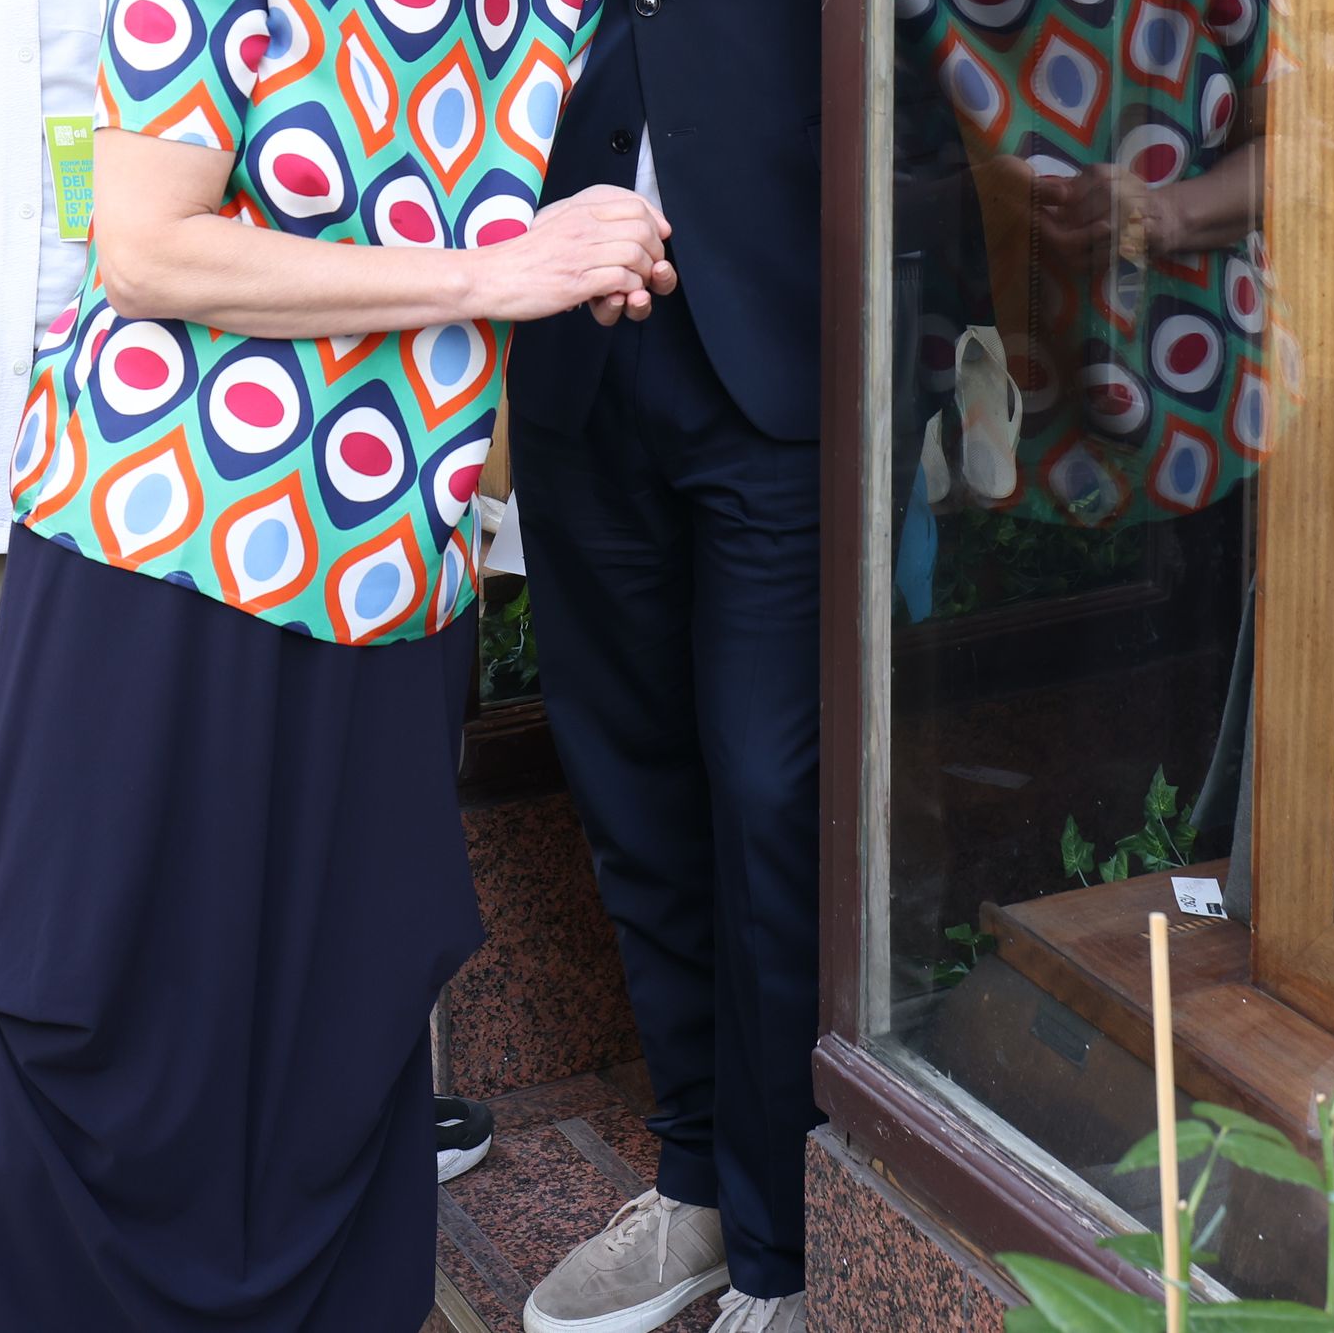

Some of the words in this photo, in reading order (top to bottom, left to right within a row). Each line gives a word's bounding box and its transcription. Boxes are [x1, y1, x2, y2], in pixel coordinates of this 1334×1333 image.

[63, 175, 85, 188] DEI
[64, 188, 93, 201] DUR
[67, 215, 89, 228] WU
